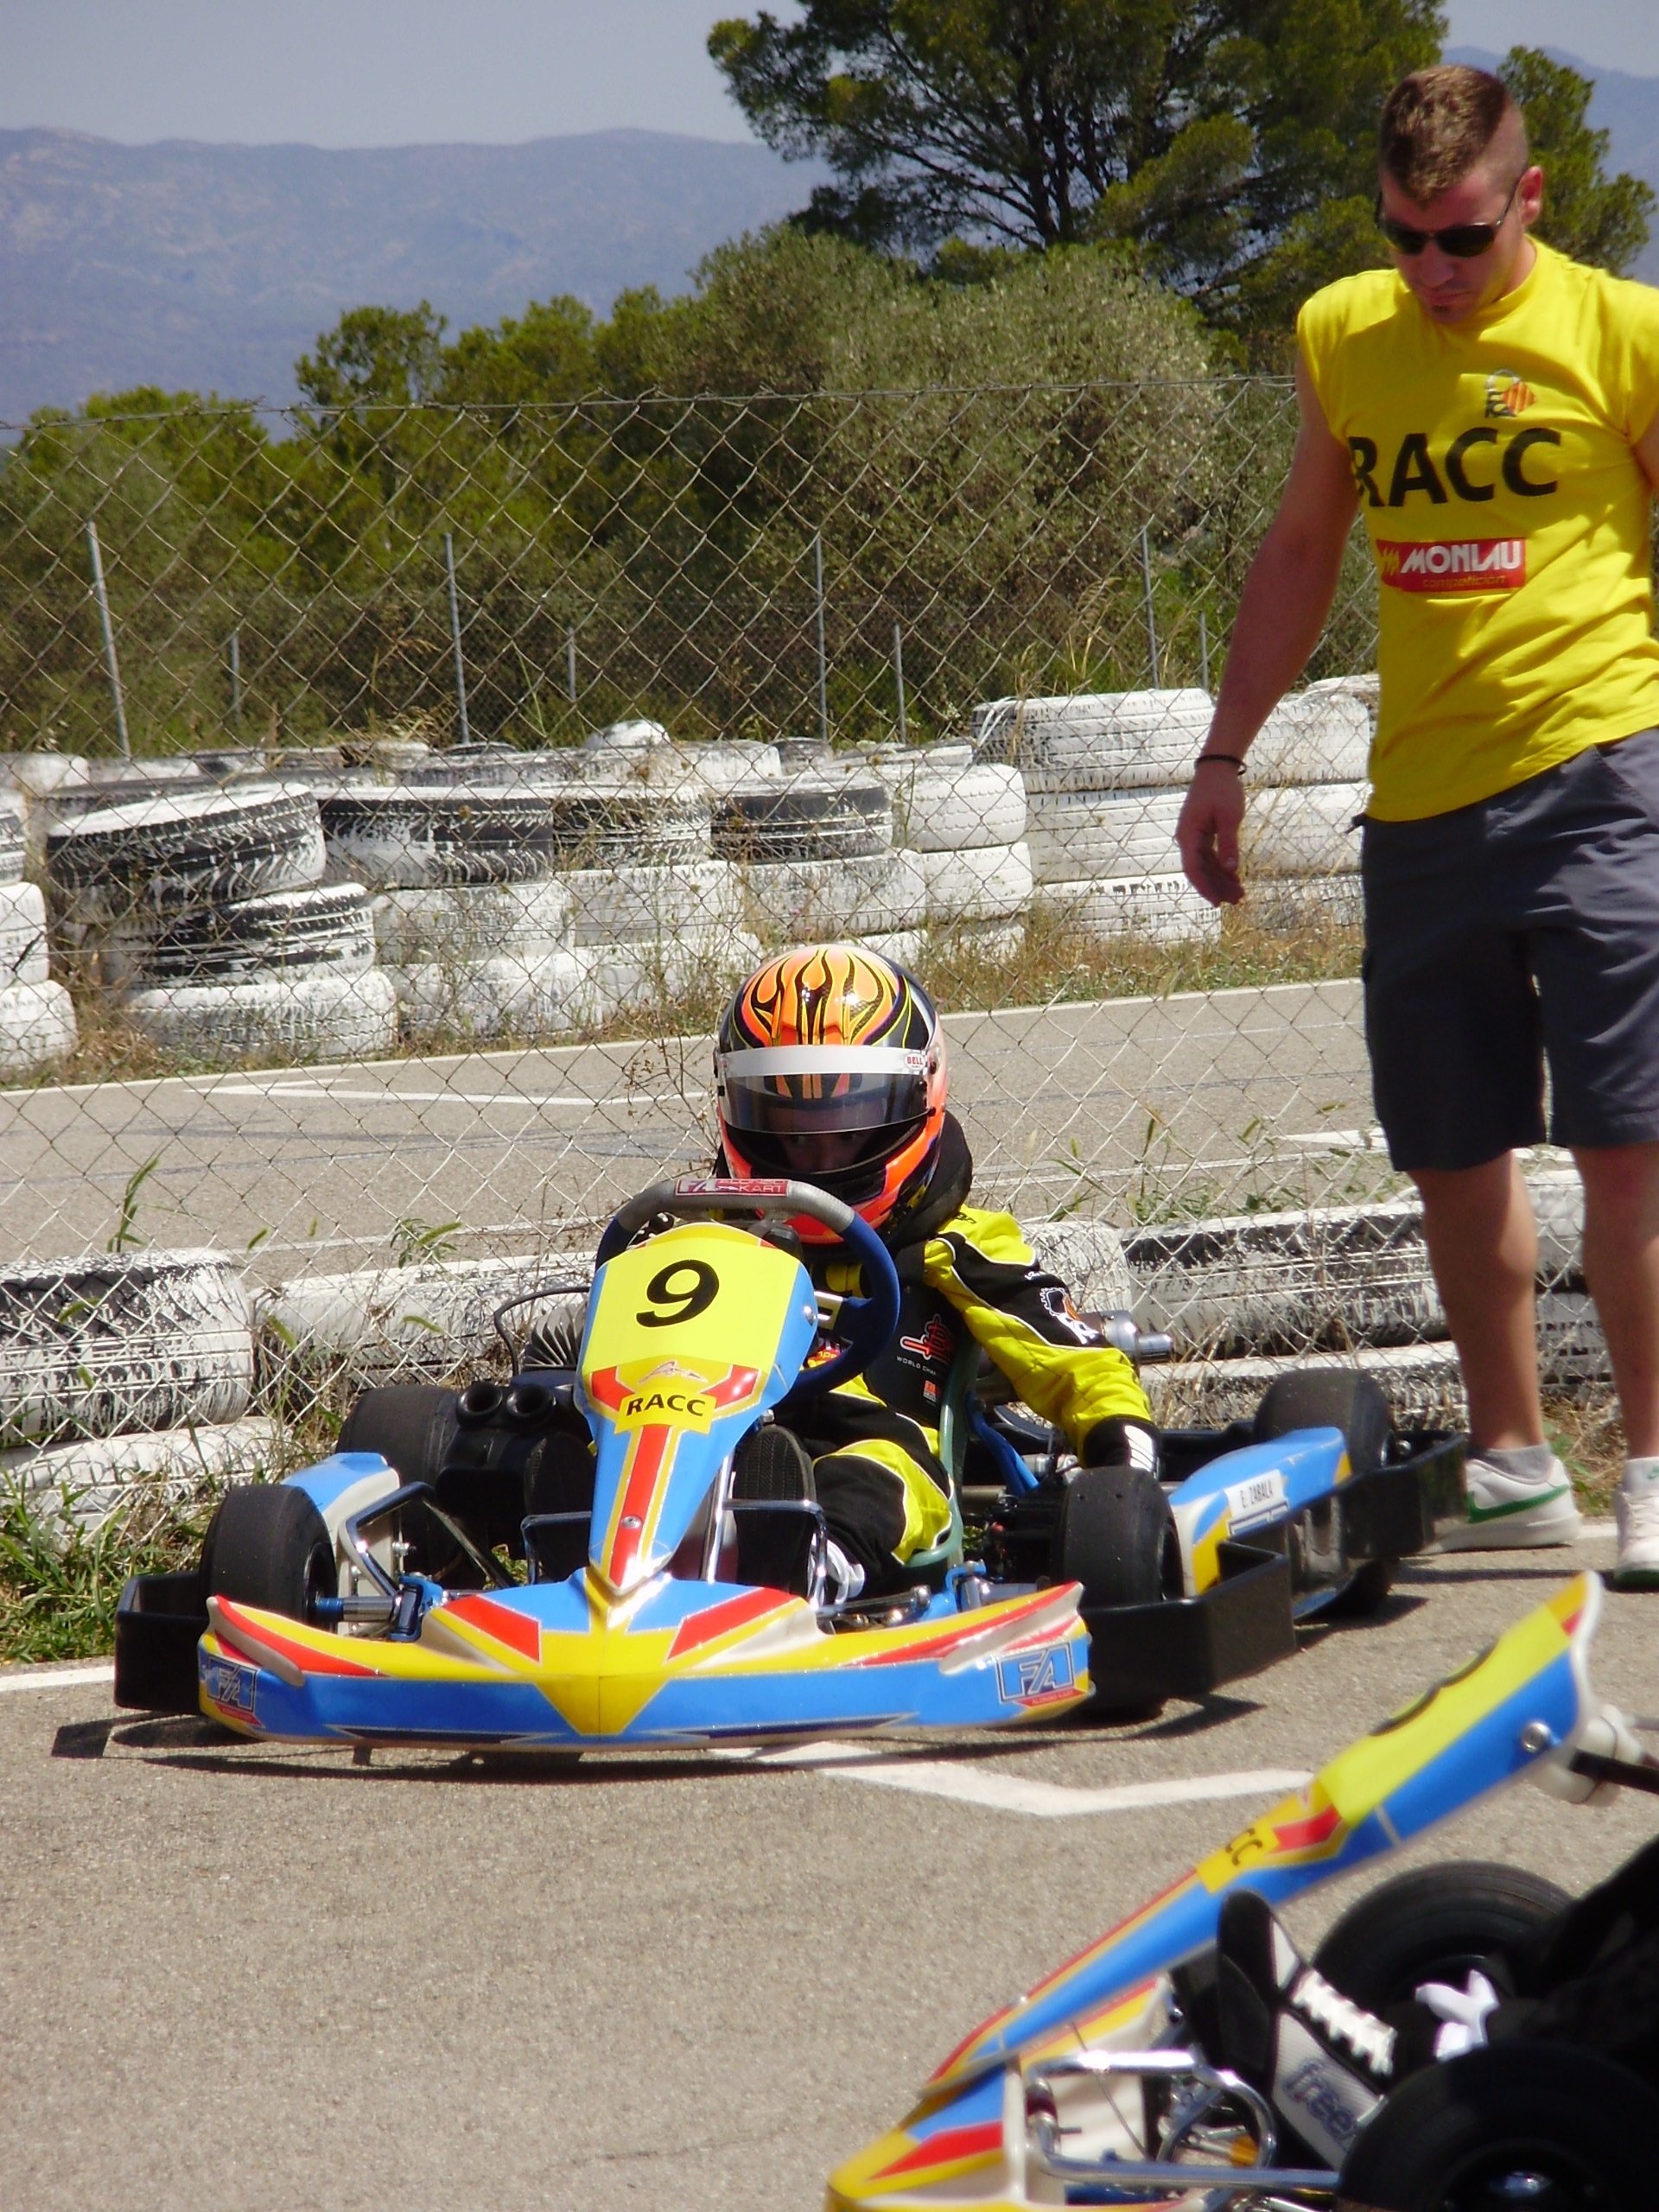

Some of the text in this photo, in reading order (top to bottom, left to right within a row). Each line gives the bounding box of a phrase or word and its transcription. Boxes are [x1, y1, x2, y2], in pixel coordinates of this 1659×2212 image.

[1348, 427, 1561, 507] RACC
[1400, 540, 1521, 574] MONLAU
[906, 1056, 924, 1065] BELL
[739, 1185, 782, 1193] KART
[636, 1259, 720, 1328] 9
[896, 1355, 921, 1369] WORLD
[626, 1393, 707, 1417] RACC
